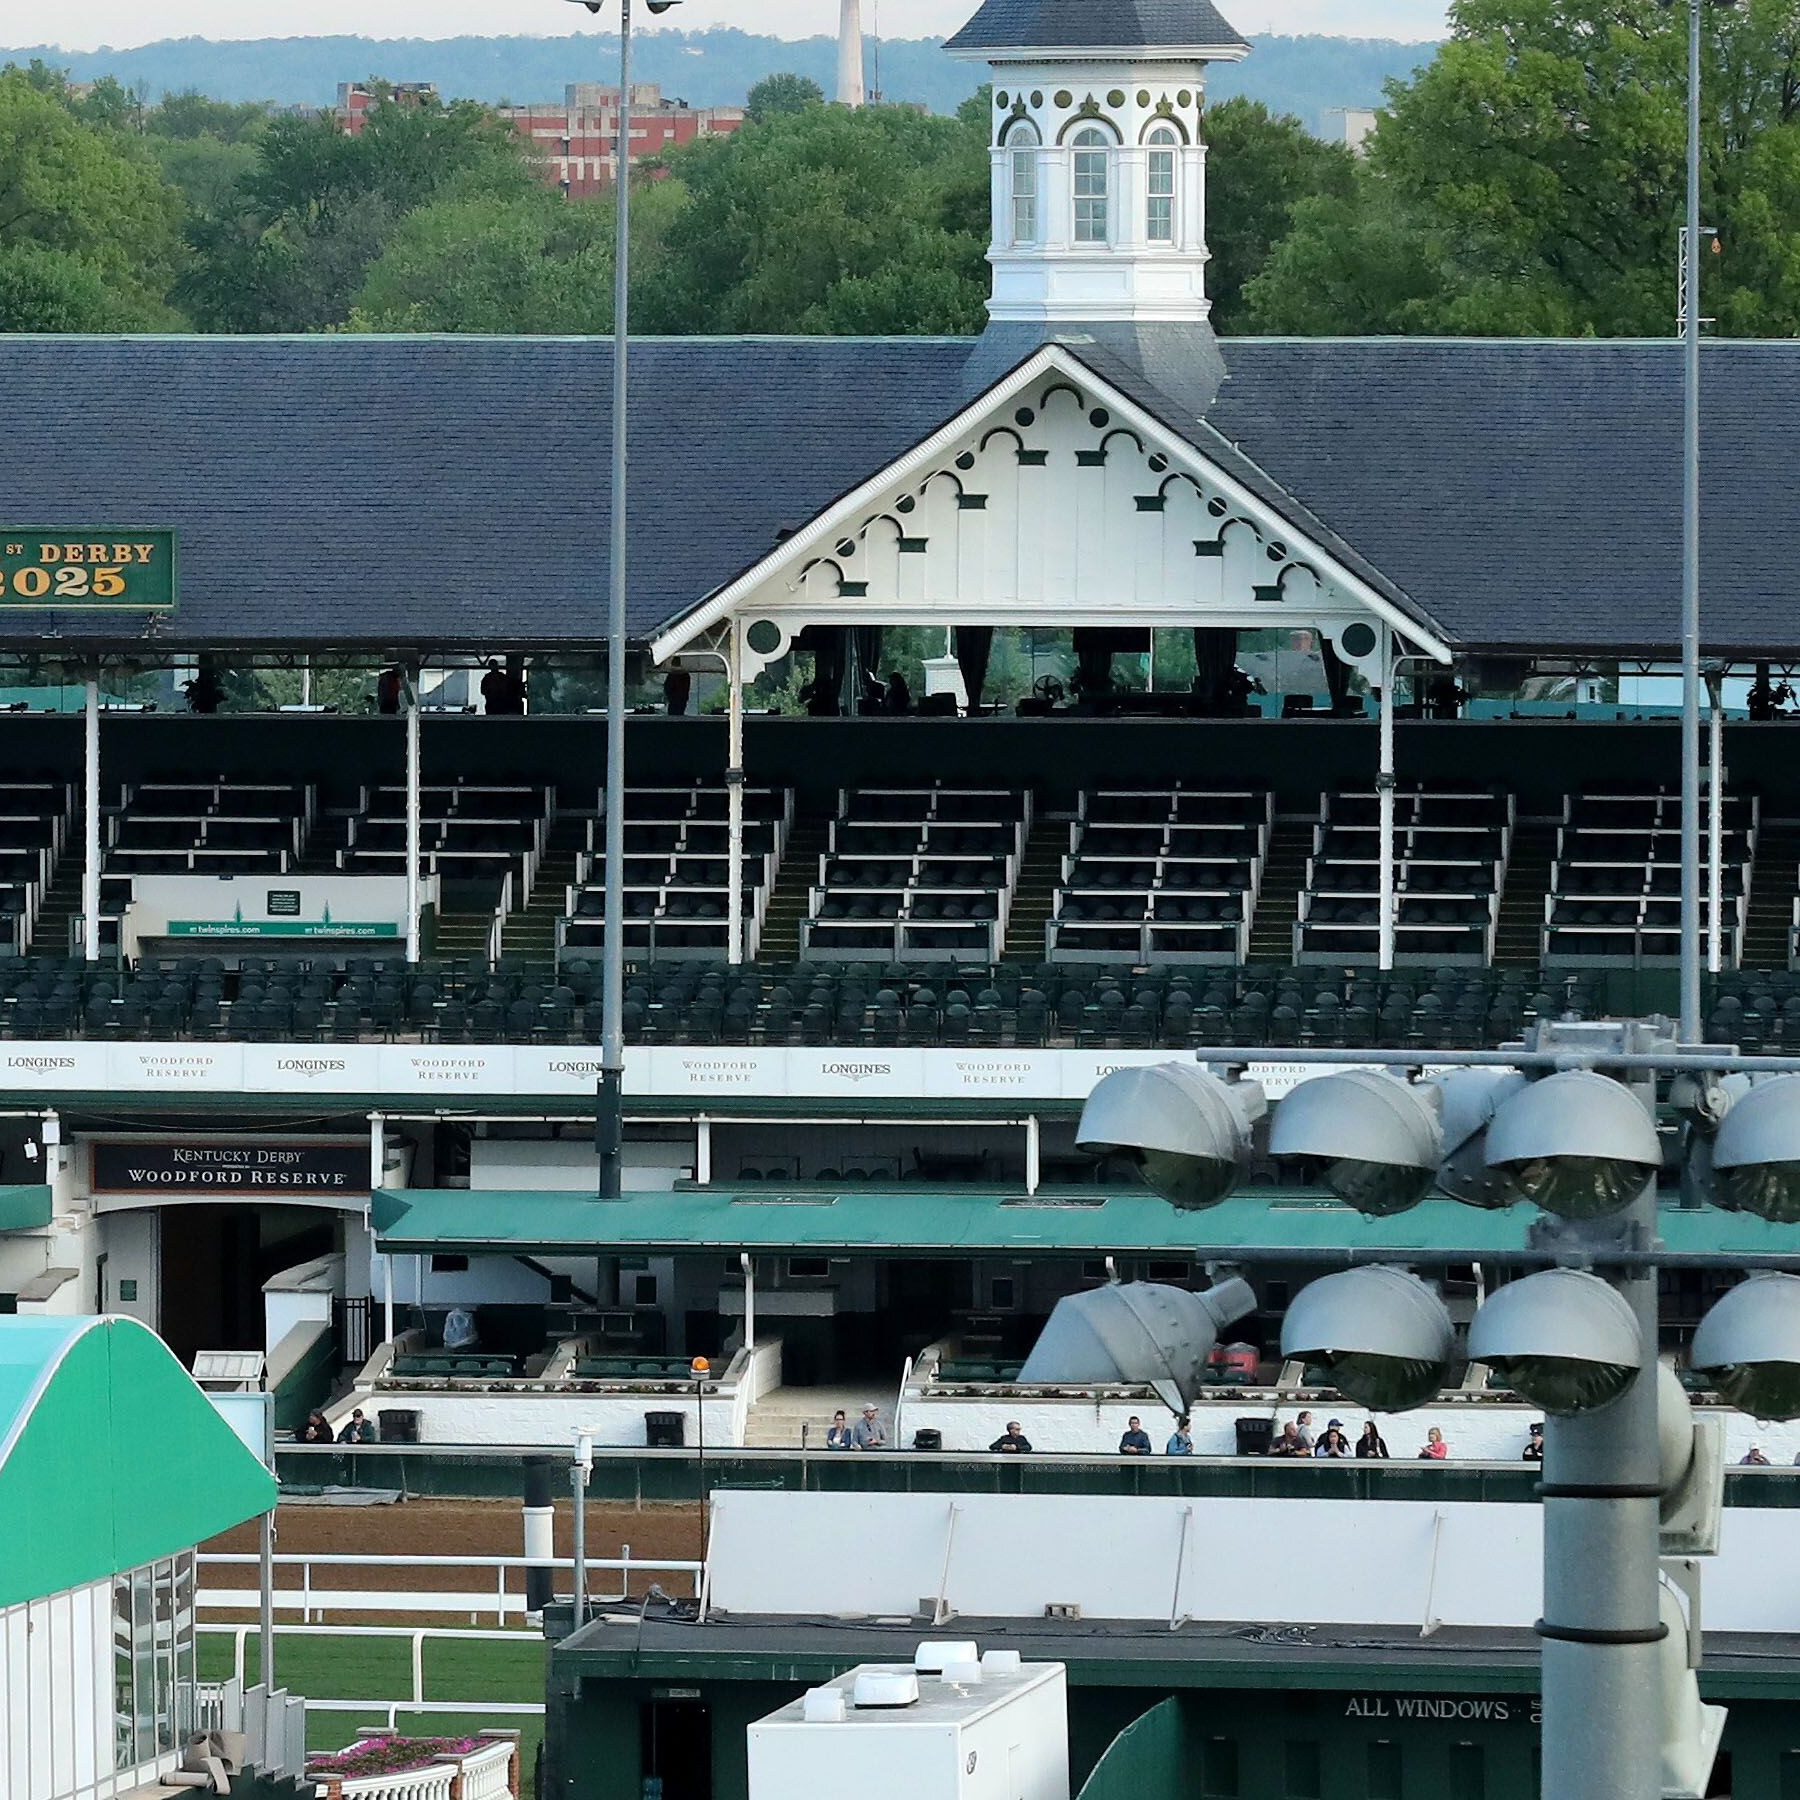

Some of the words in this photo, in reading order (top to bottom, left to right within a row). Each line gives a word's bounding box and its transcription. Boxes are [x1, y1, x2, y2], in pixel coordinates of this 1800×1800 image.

[39, 544, 153, 563] DERBY
[7, 1056, 76, 1068] LONGINES
[139, 1056, 213, 1065] WOODFORD
[277, 1059, 346, 1071] LONGINES
[410, 1058, 486, 1068] WOODFORD
[682, 1061, 758, 1070] WOODFORD
[548, 1061, 601, 1073] LONGIN
[821, 1063, 891, 1075] LONGINES
[956, 1062, 1031, 1072] WOODFORD
[1251, 1065, 1307, 1073] ODFORD
[146, 1068, 205, 1077] RESERVE
[418, 1071, 479, 1080] RESERVE
[690, 1073, 751, 1082] RESERVE
[963, 1074, 1024, 1084] RESERVE
[174, 1149, 250, 1163] KENTUCKY
[256, 1150, 303, 1164] DERBY
[129, 1170, 241, 1182] WOODFORD
[252, 1171, 343, 1184] RESERVE
[1344, 1698, 1390, 1717] ALL
[1397, 1700, 1508, 1719] WINDOWS
